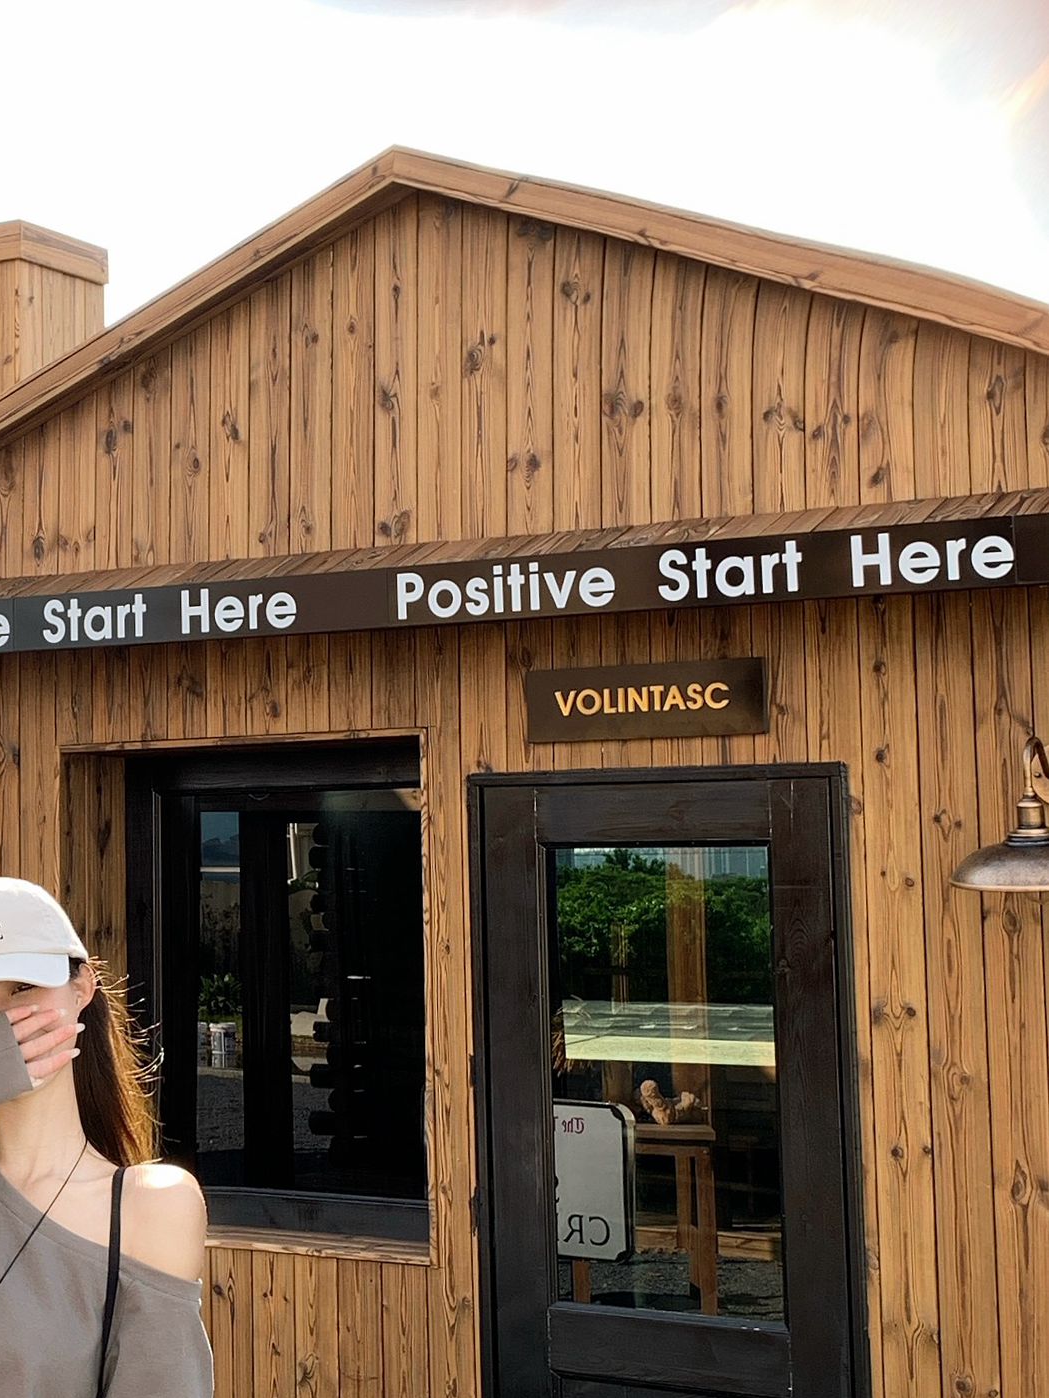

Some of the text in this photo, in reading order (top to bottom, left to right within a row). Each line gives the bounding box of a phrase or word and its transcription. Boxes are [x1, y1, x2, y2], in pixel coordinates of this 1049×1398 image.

[395, 533, 1015, 620] Positive Start Here
[42, 593, 147, 644] Start
[178, 588, 297, 634] Here
[554, 682, 730, 717] VOLINTASC
